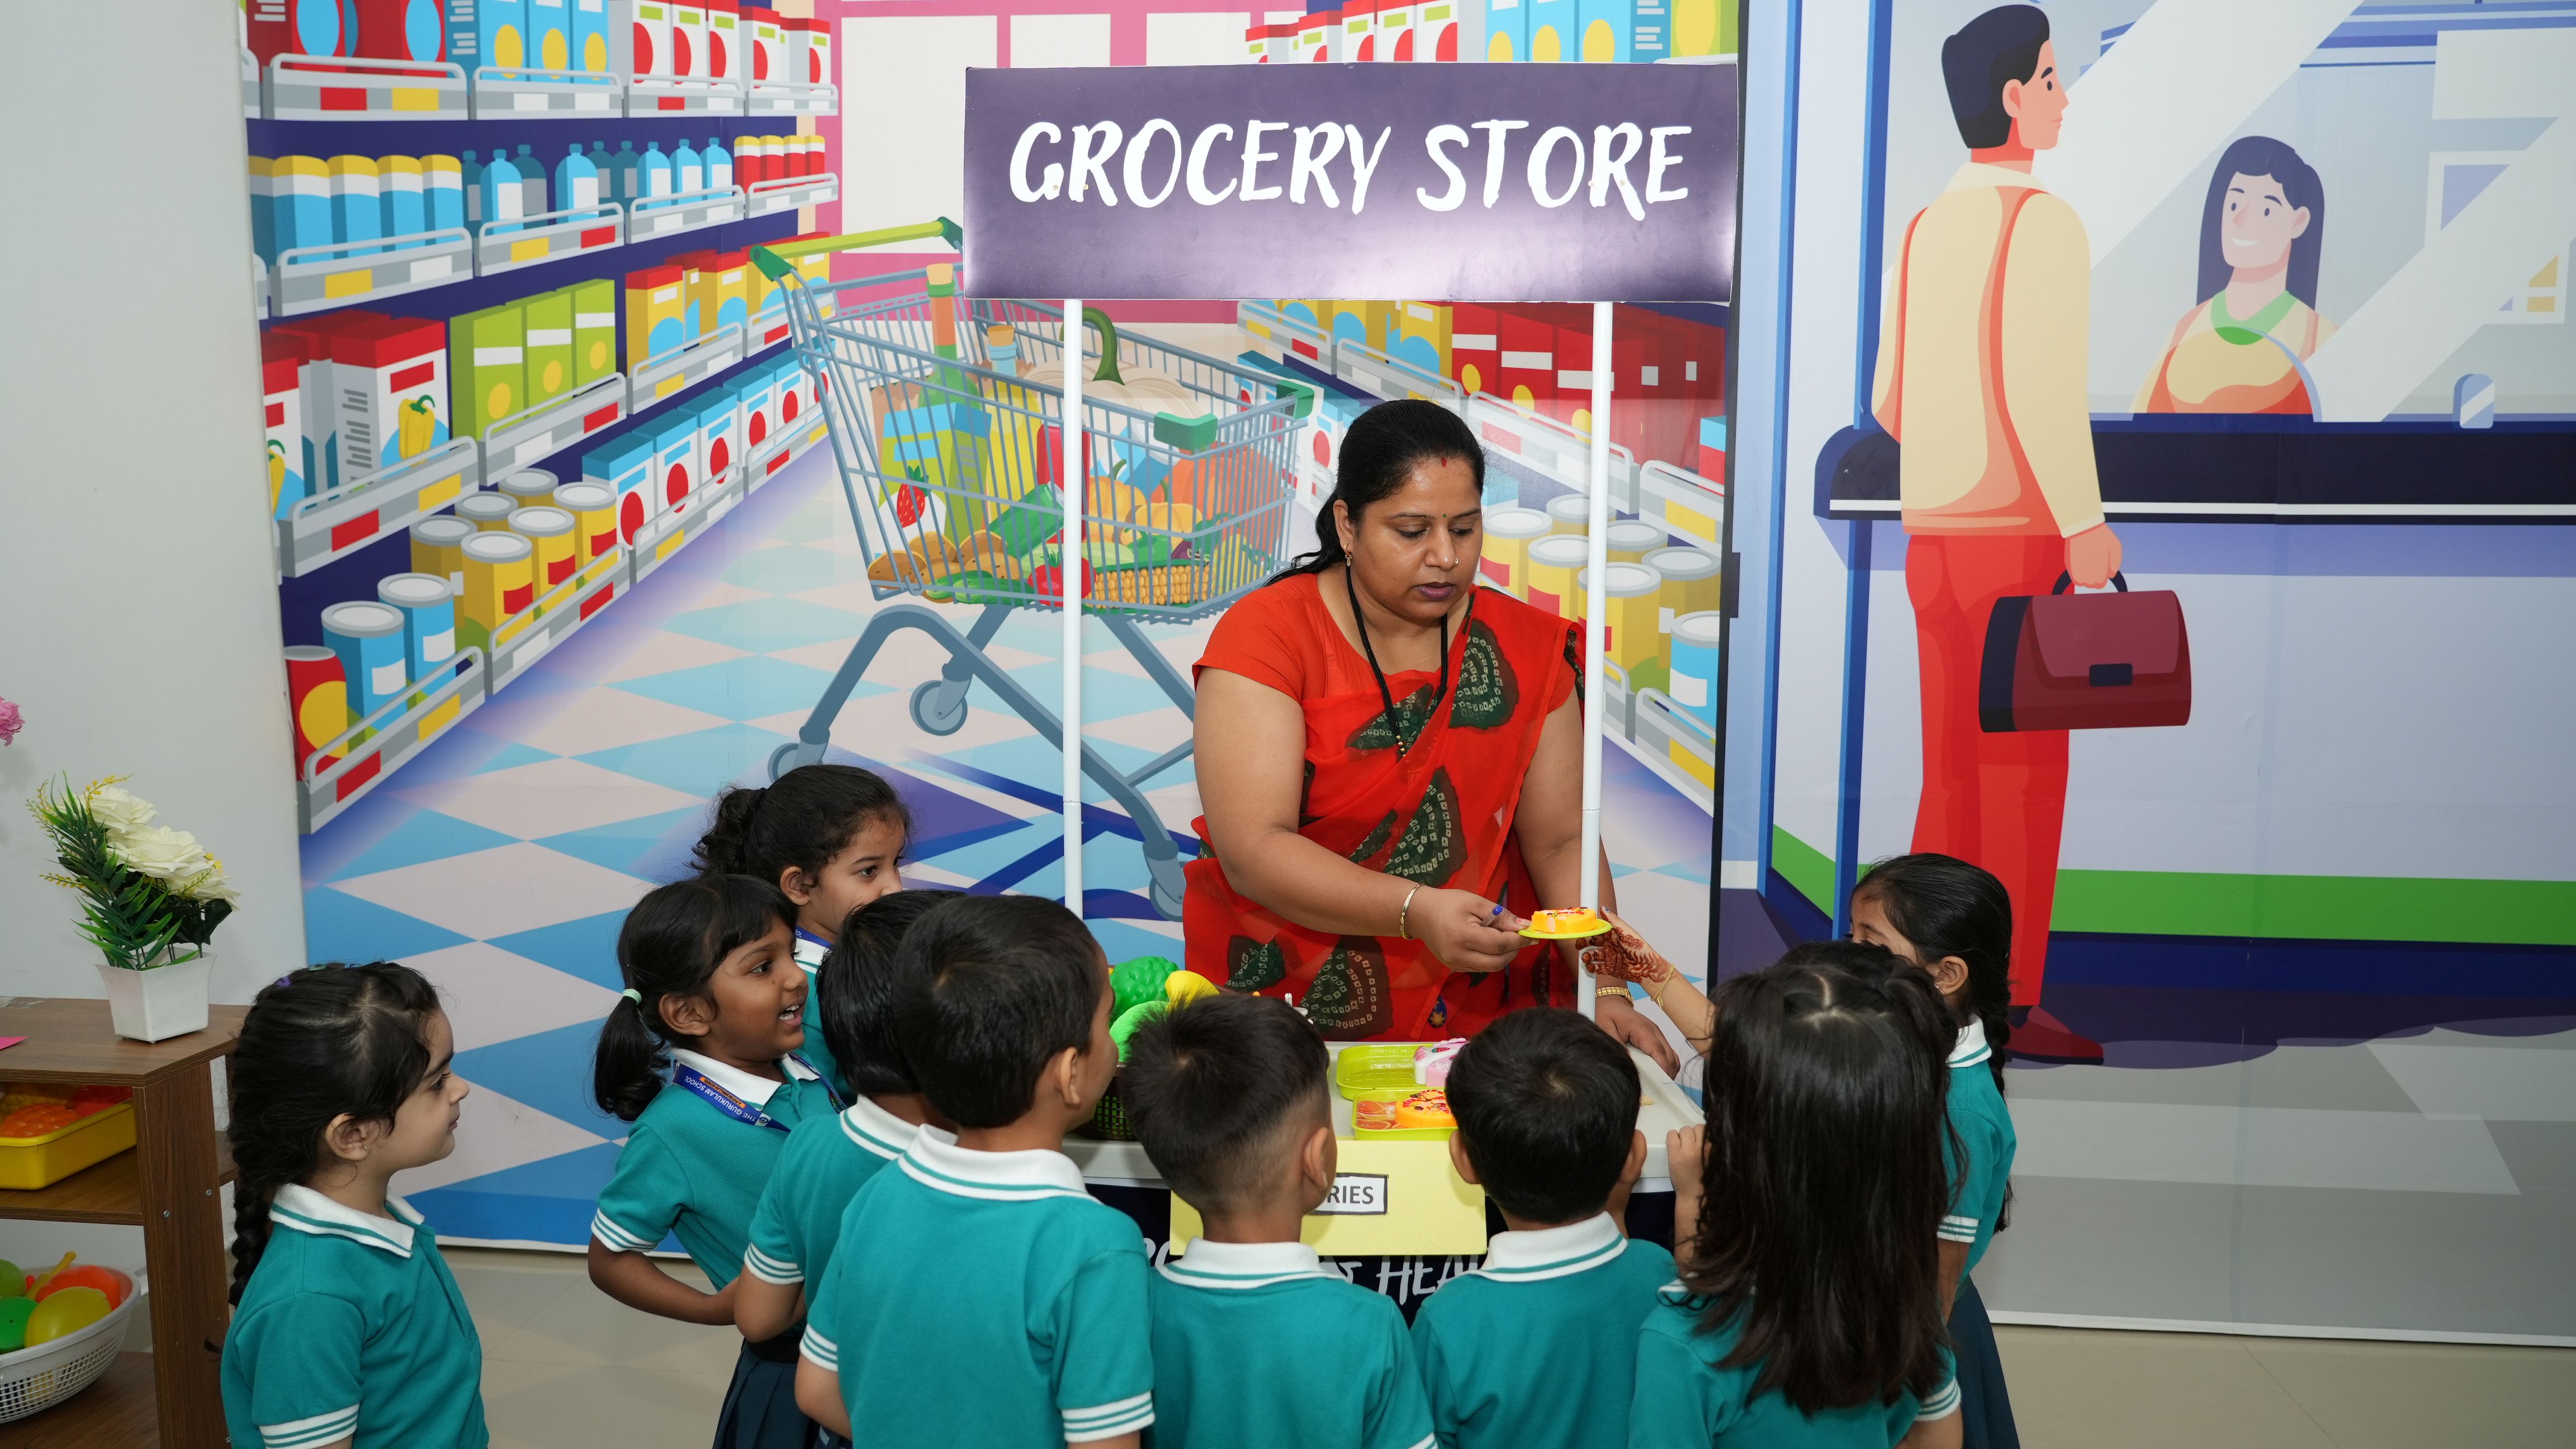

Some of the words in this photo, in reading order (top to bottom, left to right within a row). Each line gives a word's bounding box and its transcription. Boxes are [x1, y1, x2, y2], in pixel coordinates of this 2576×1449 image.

[1010, 118, 1391, 215] GROCERY
[1417, 120, 1693, 221] STORE
[684, 1075, 706, 1091] SCHOOL
[704, 1088, 742, 1115] GURUKULAM
[743, 1112, 756, 1122] THE
